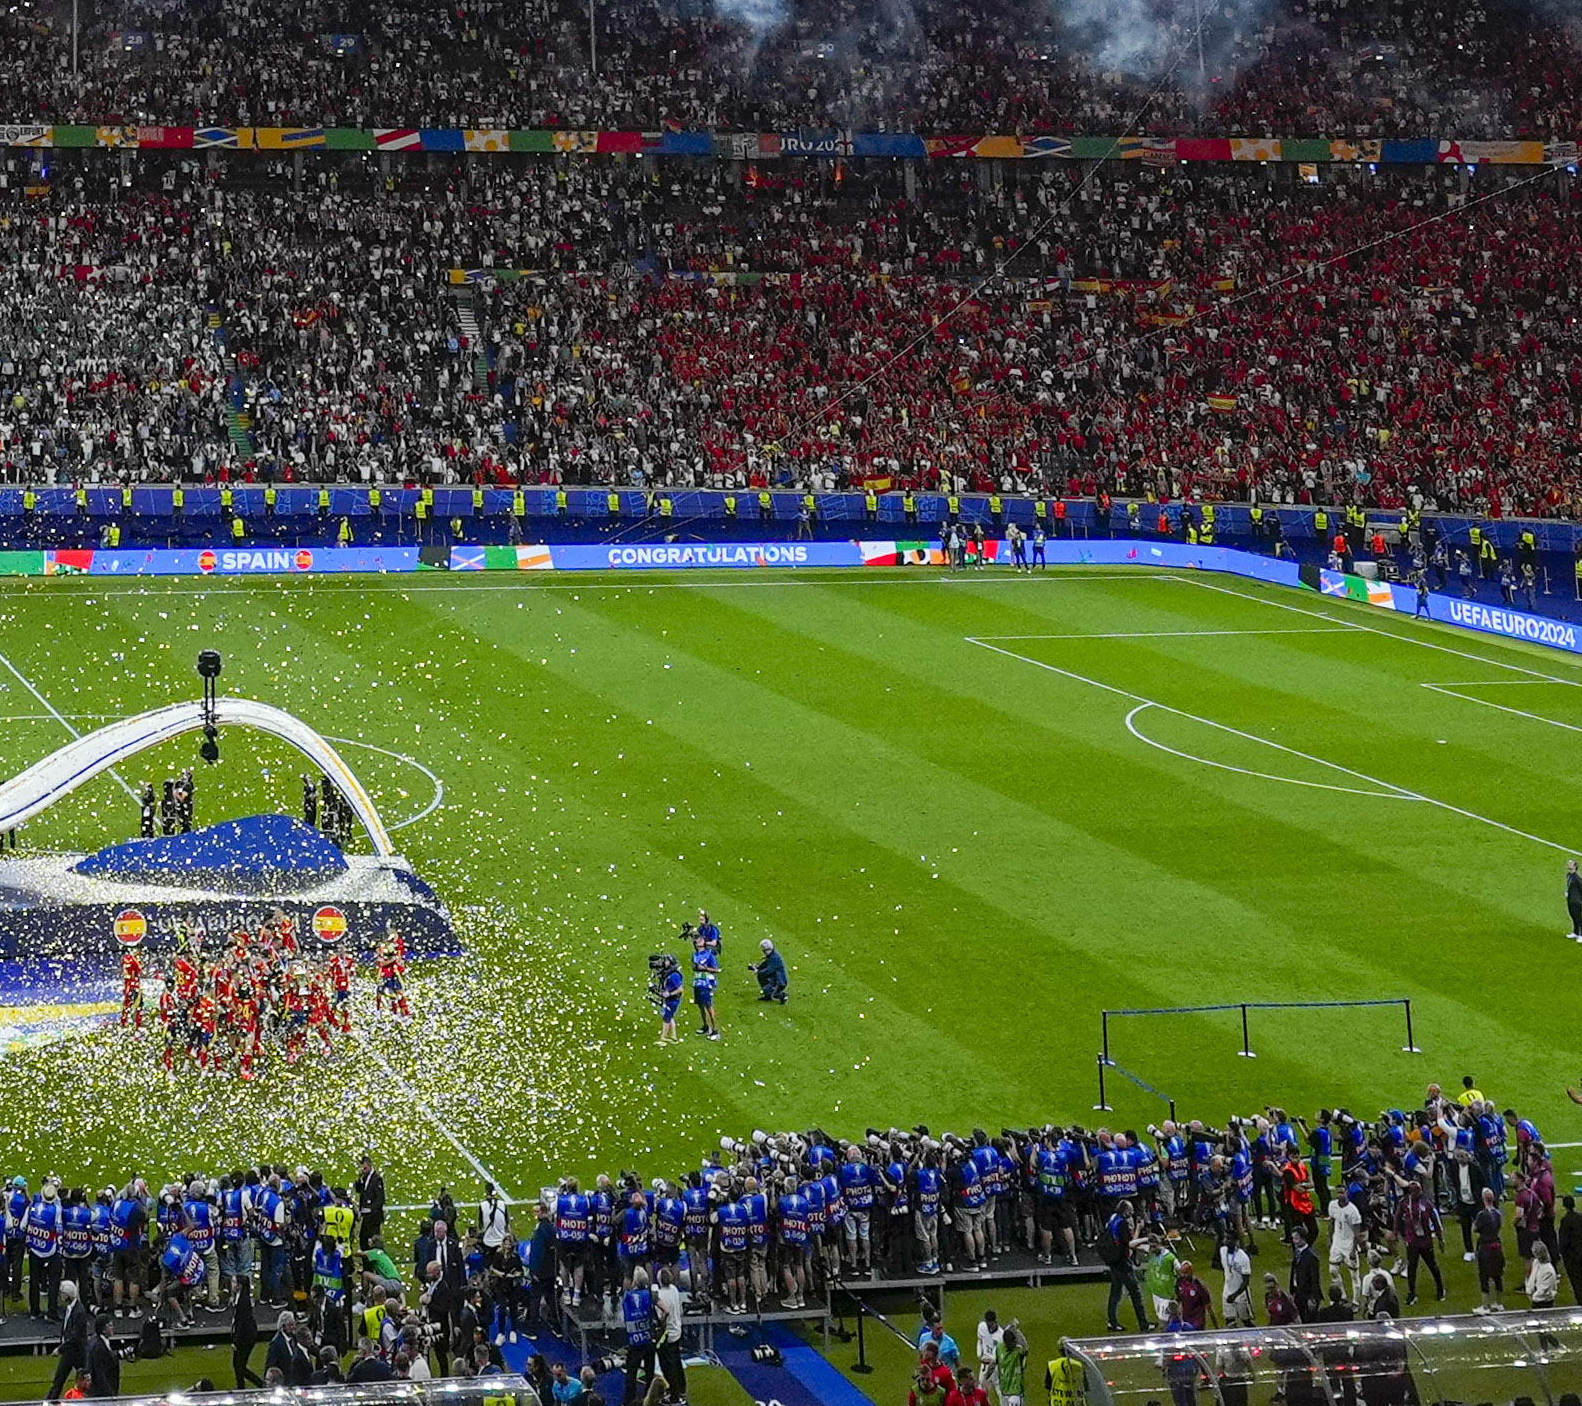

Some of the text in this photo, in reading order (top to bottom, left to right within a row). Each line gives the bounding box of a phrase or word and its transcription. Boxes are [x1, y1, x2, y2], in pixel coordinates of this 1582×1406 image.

[340, 38, 354, 47] 29
[817, 44, 834, 52] 30
[222, 550, 289, 570] SPAIN
[608, 545, 808, 565] CONGRATULATIONS
[561, 1220, 587, 1230] PHOTO
